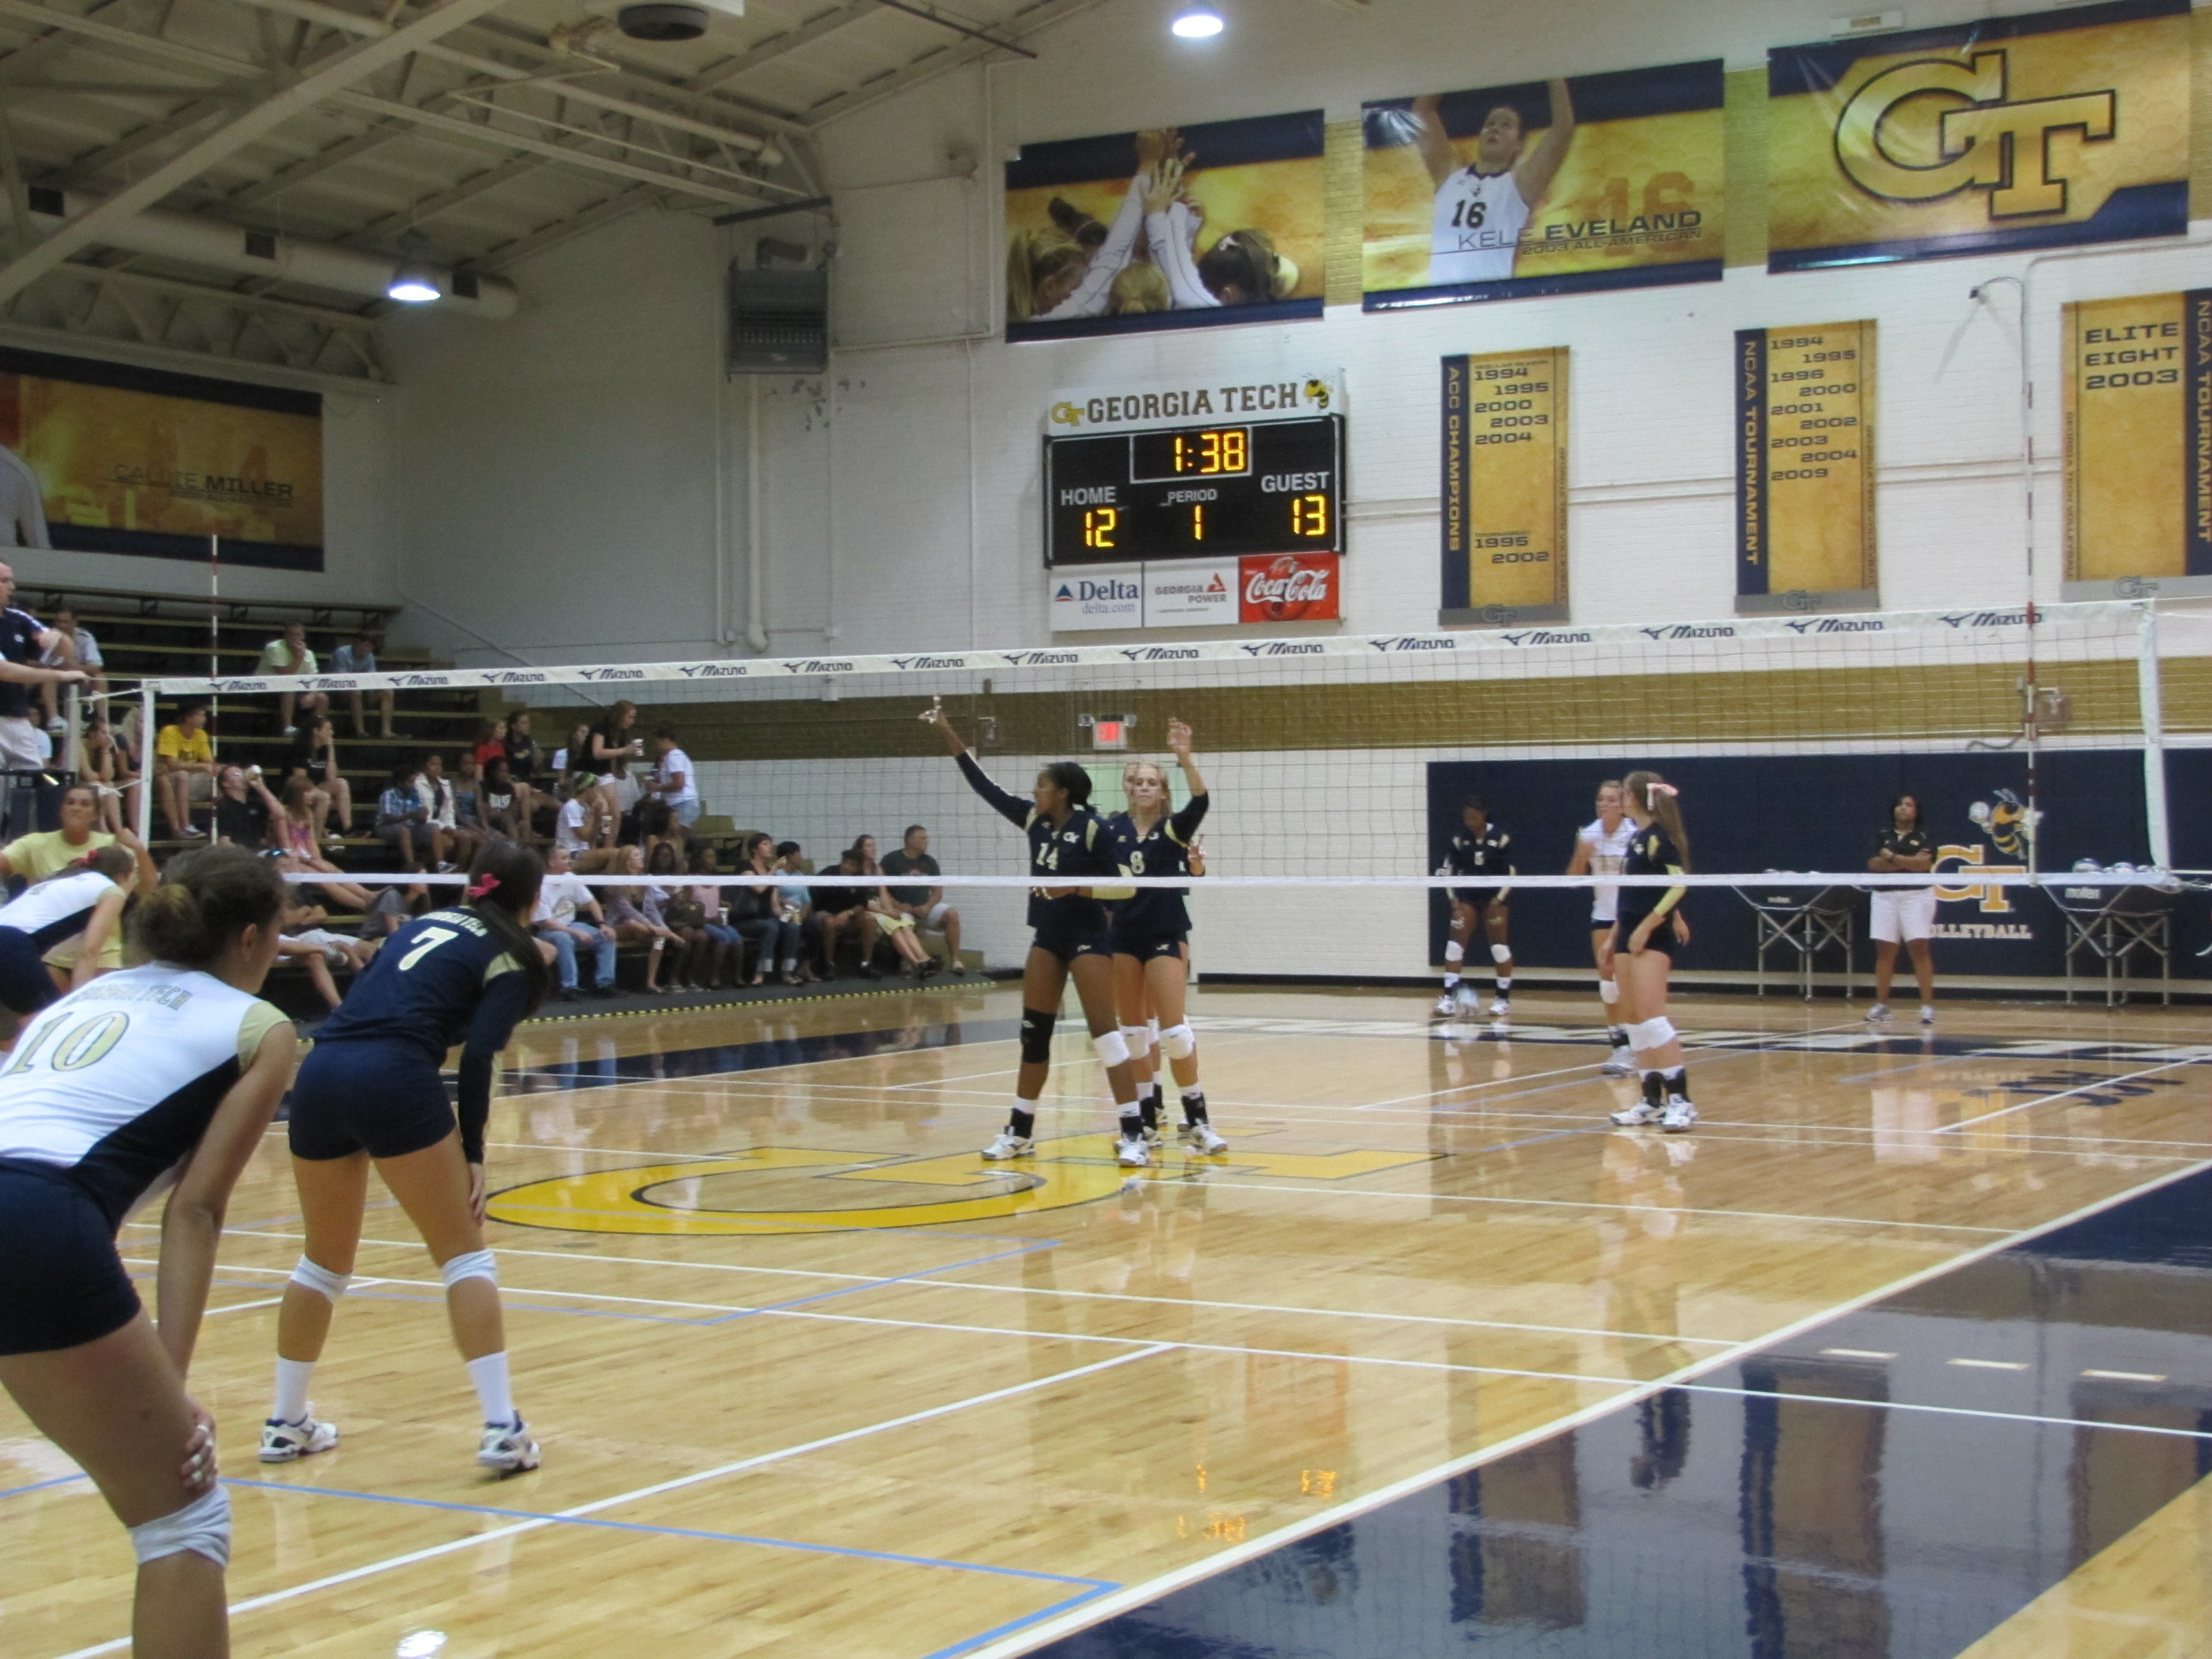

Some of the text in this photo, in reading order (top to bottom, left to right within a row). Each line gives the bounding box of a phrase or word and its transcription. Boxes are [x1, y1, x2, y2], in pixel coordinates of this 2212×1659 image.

[1834, 49, 2116, 221] GT
[1451, 199, 1486, 228] 16
[1546, 211, 1701, 241] EVELAND
[2085, 322, 2179, 344] ELITE
[1771, 336, 1823, 349] 1994
[1802, 349, 1855, 363] 1995
[2085, 347, 2178, 366] EIGHT
[1475, 367, 1528, 380] 1994
[1770, 369, 1824, 382] 1996
[2085, 369, 2179, 390] 2003
[1495, 382, 1548, 396] 1995
[1800, 383, 1856, 396] 2000
[1087, 389, 1213, 424] GEORGIA
[1220, 382, 1298, 412] TECH
[1474, 399, 1532, 412] 2000
[1771, 403, 1824, 415] 2001
[1490, 415, 1548, 427] 2003
[1801, 417, 1857, 430] 2002
[2198, 301, 2212, 541] NCAA TOURNAMENT
[1475, 432, 1532, 445] 2004
[1771, 435, 1828, 448] 2003
[1175, 432, 1245, 472] 1:38
[1448, 367, 1461, 551] ACC CHAMPIONS
[1745, 342, 1758, 565] NCAA TOURNAMENT
[1801, 450, 1857, 463] 2004
[1770, 468, 1828, 480] 2009
[206, 474, 293, 497] MILLER
[1261, 472, 1330, 493] GUEST
[1061, 487, 1117, 506] HOME
[1167, 488, 1218, 503] PERIOD
[1293, 495, 1325, 535] 13
[1085, 509, 1116, 547] 12
[1194, 505, 1202, 540] 1
[1475, 536, 1528, 549] 1995
[1492, 551, 1550, 564] 2002
[1079, 580, 1139, 601] Delta
[1155, 585, 1203, 595] GEORGIA
[1246, 570, 1330, 603] Coca-Cola
[1188, 594, 1226, 603] POWER
[1082, 603, 1135, 614] delta.com
[1670, 625, 1734, 639] MIZUNO
[1816, 618, 1884, 633] MIZUNO
[1396, 638, 1455, 650] MIZUNO
[1530, 631, 1591, 644] MIZUNO
[1146, 648, 1200, 660] MIZUNO
[1268, 642, 1324, 655] MIZUNO
[1027, 652, 1078, 664] MIZUNO
[1036, 843, 1059, 870] 14
[1129, 851, 1145, 874] 8
[398, 926, 459, 971] 7
[4, 1010, 129, 1077] 10
